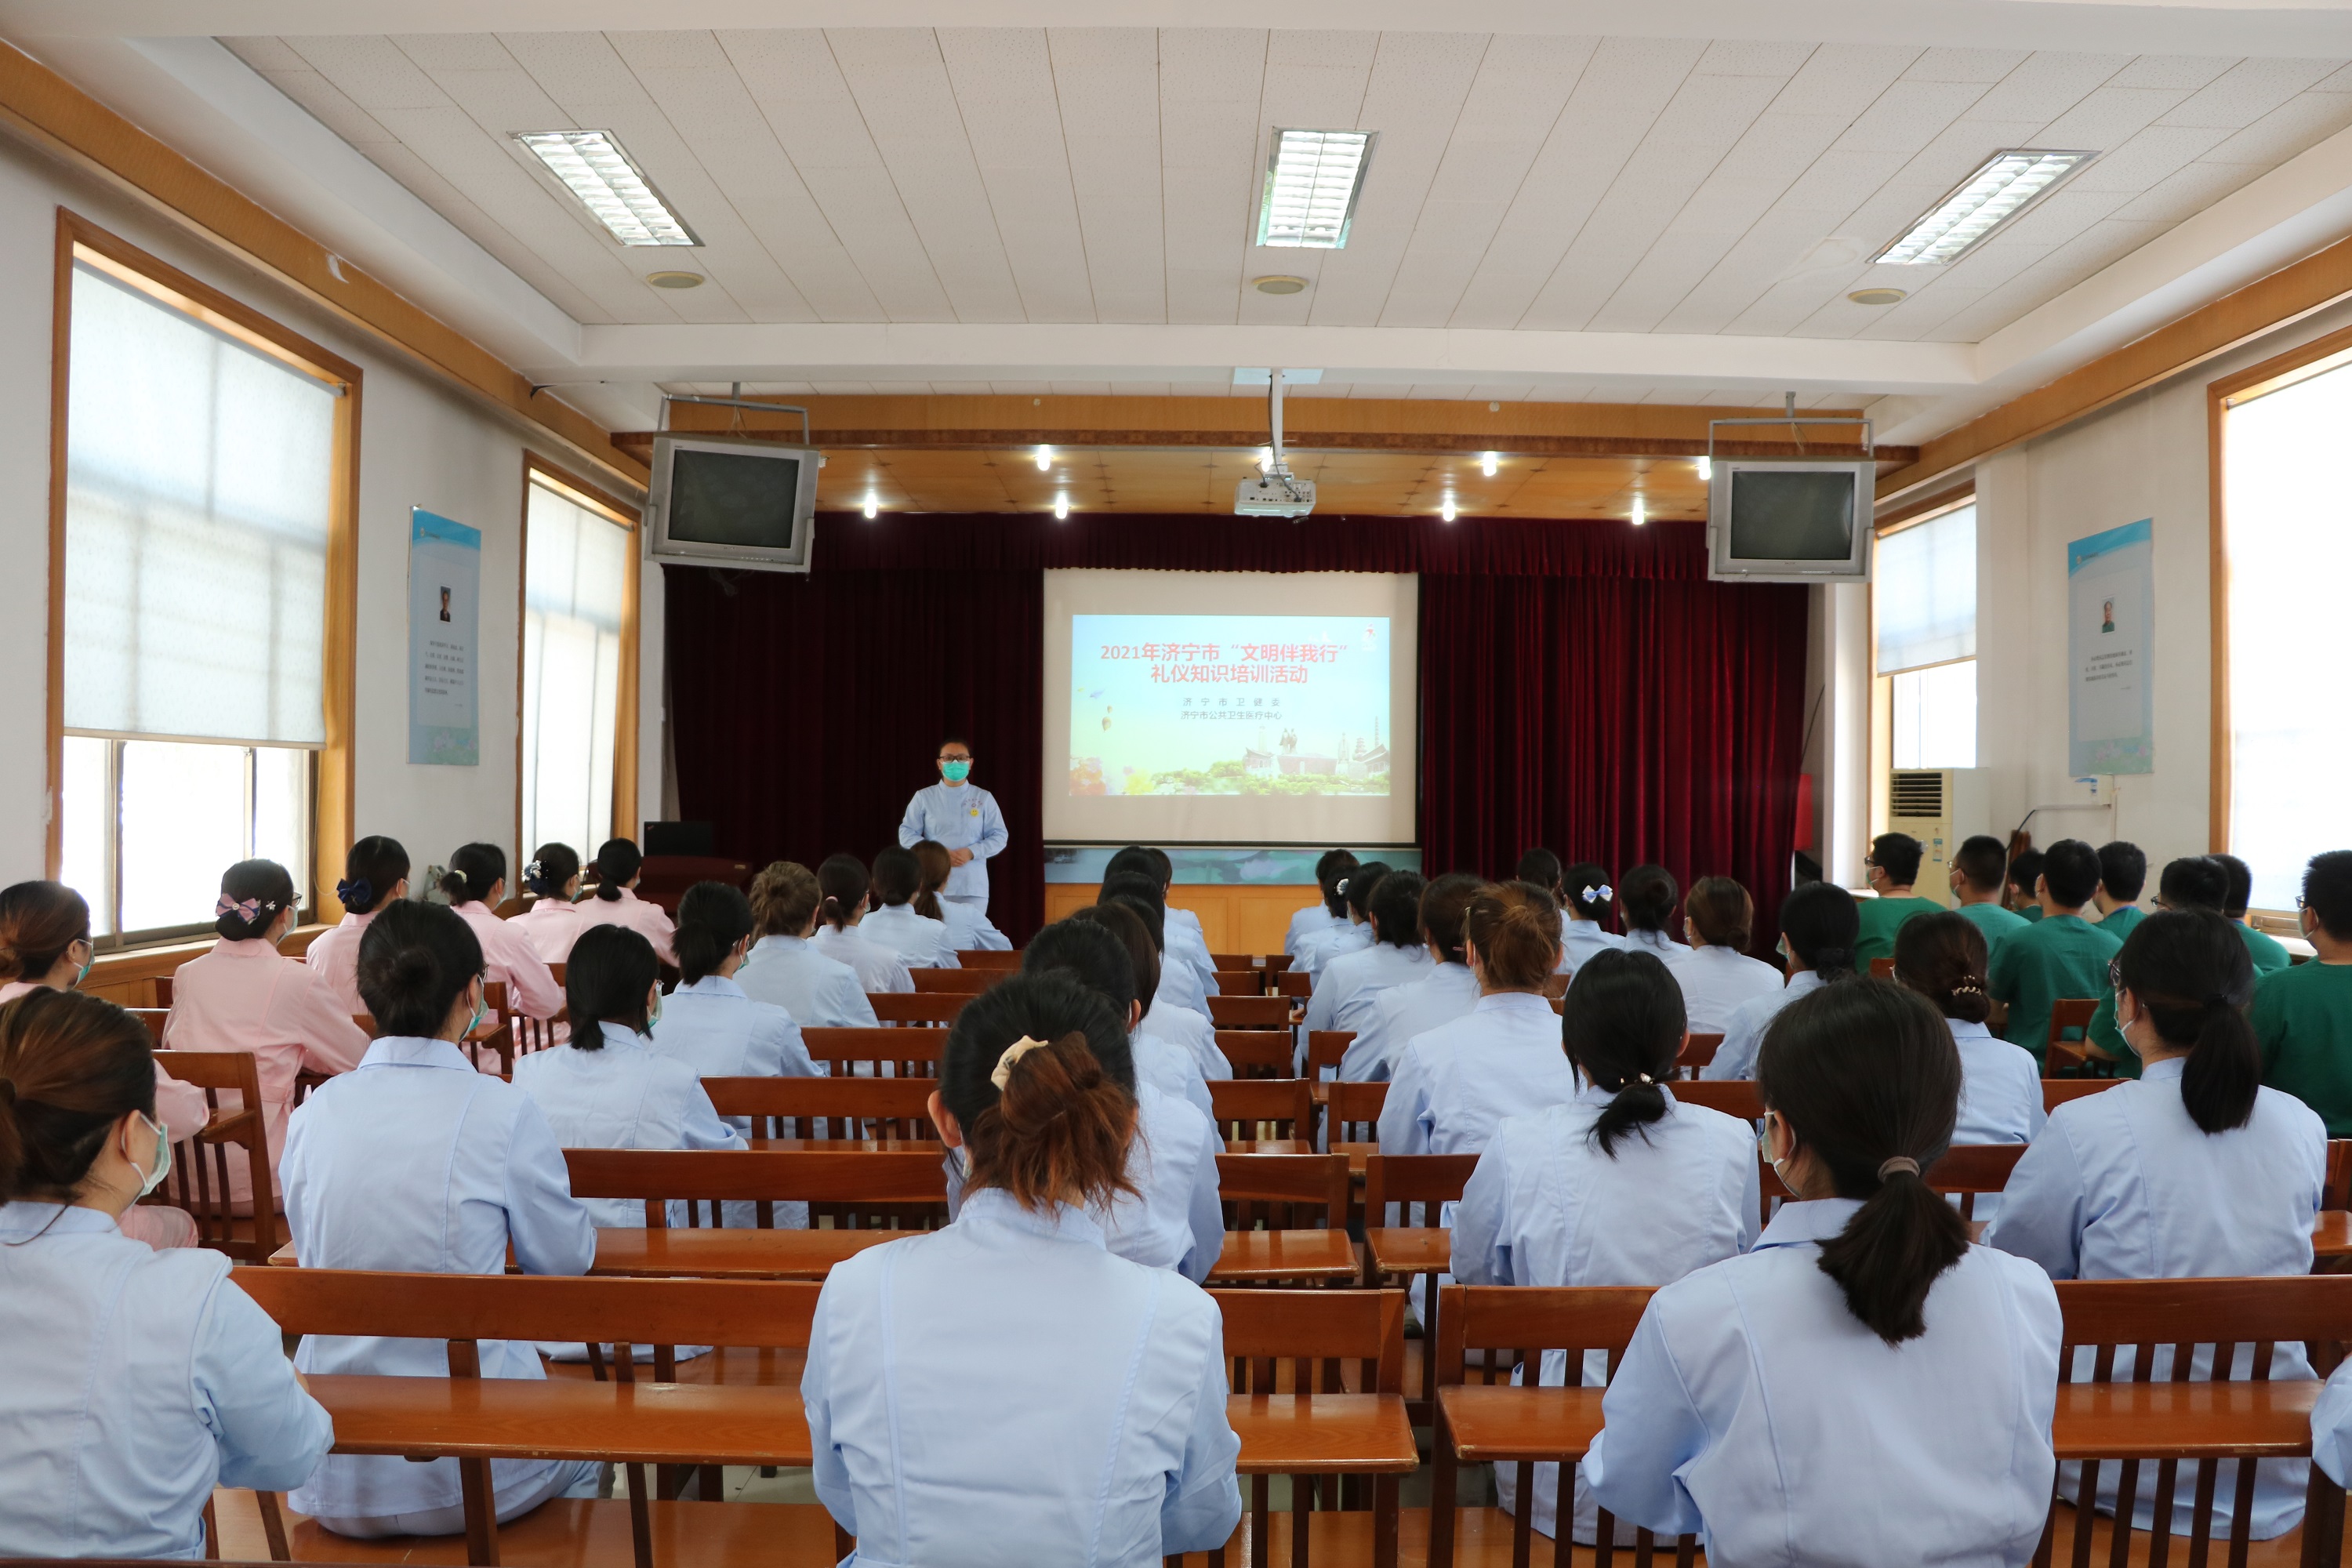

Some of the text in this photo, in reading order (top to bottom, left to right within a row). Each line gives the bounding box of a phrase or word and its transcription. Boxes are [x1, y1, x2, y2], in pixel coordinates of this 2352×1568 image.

[1150, 664, 1308, 684] 礼仪知识培训活动
[1182, 697, 1280, 707] 济宁市卫健委
[1180, 710, 1283, 720] 济宁市公共卫生医疗中心
